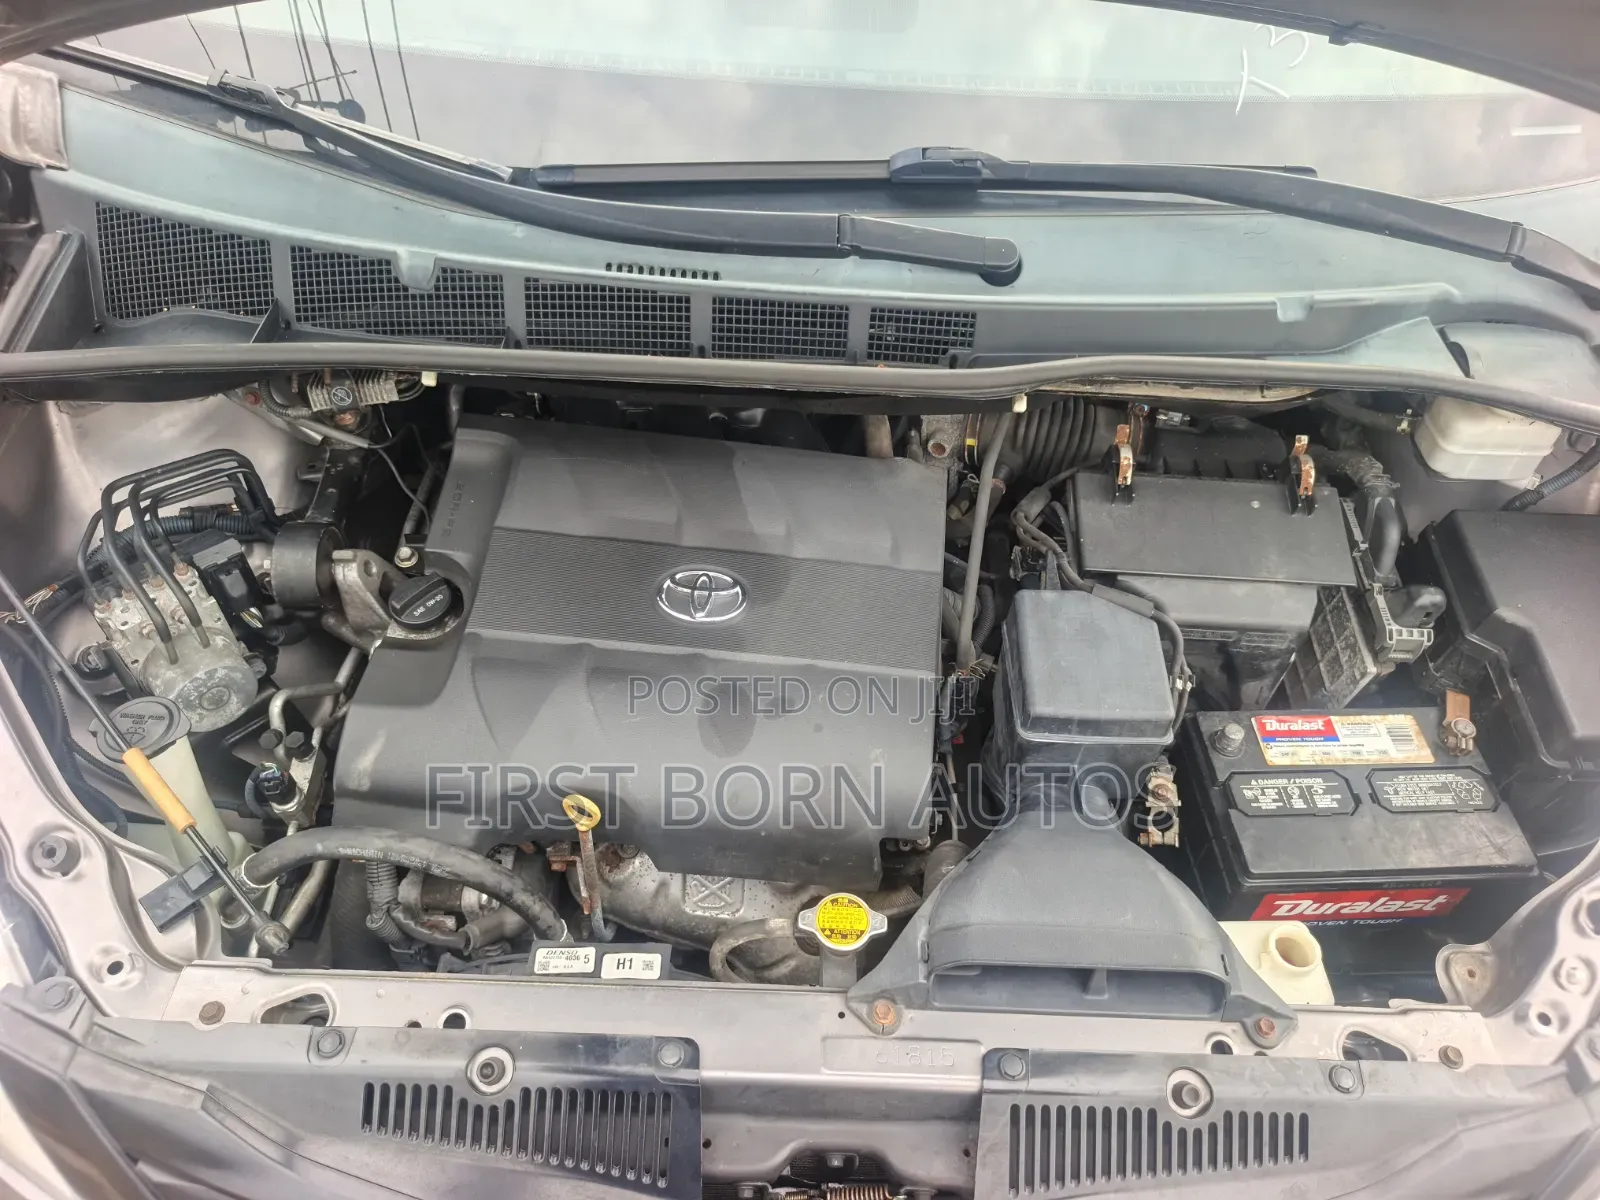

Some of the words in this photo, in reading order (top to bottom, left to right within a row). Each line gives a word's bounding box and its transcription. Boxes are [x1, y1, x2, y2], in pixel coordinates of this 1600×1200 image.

[413, 606, 426, 617] SAE
[1262, 718, 1325, 731] Duralast
[1271, 894, 1449, 917] Duralast
[583, 953, 590, 965] 5
[616, 957, 634, 971] H1
[876, 1044, 955, 1067] 61815
